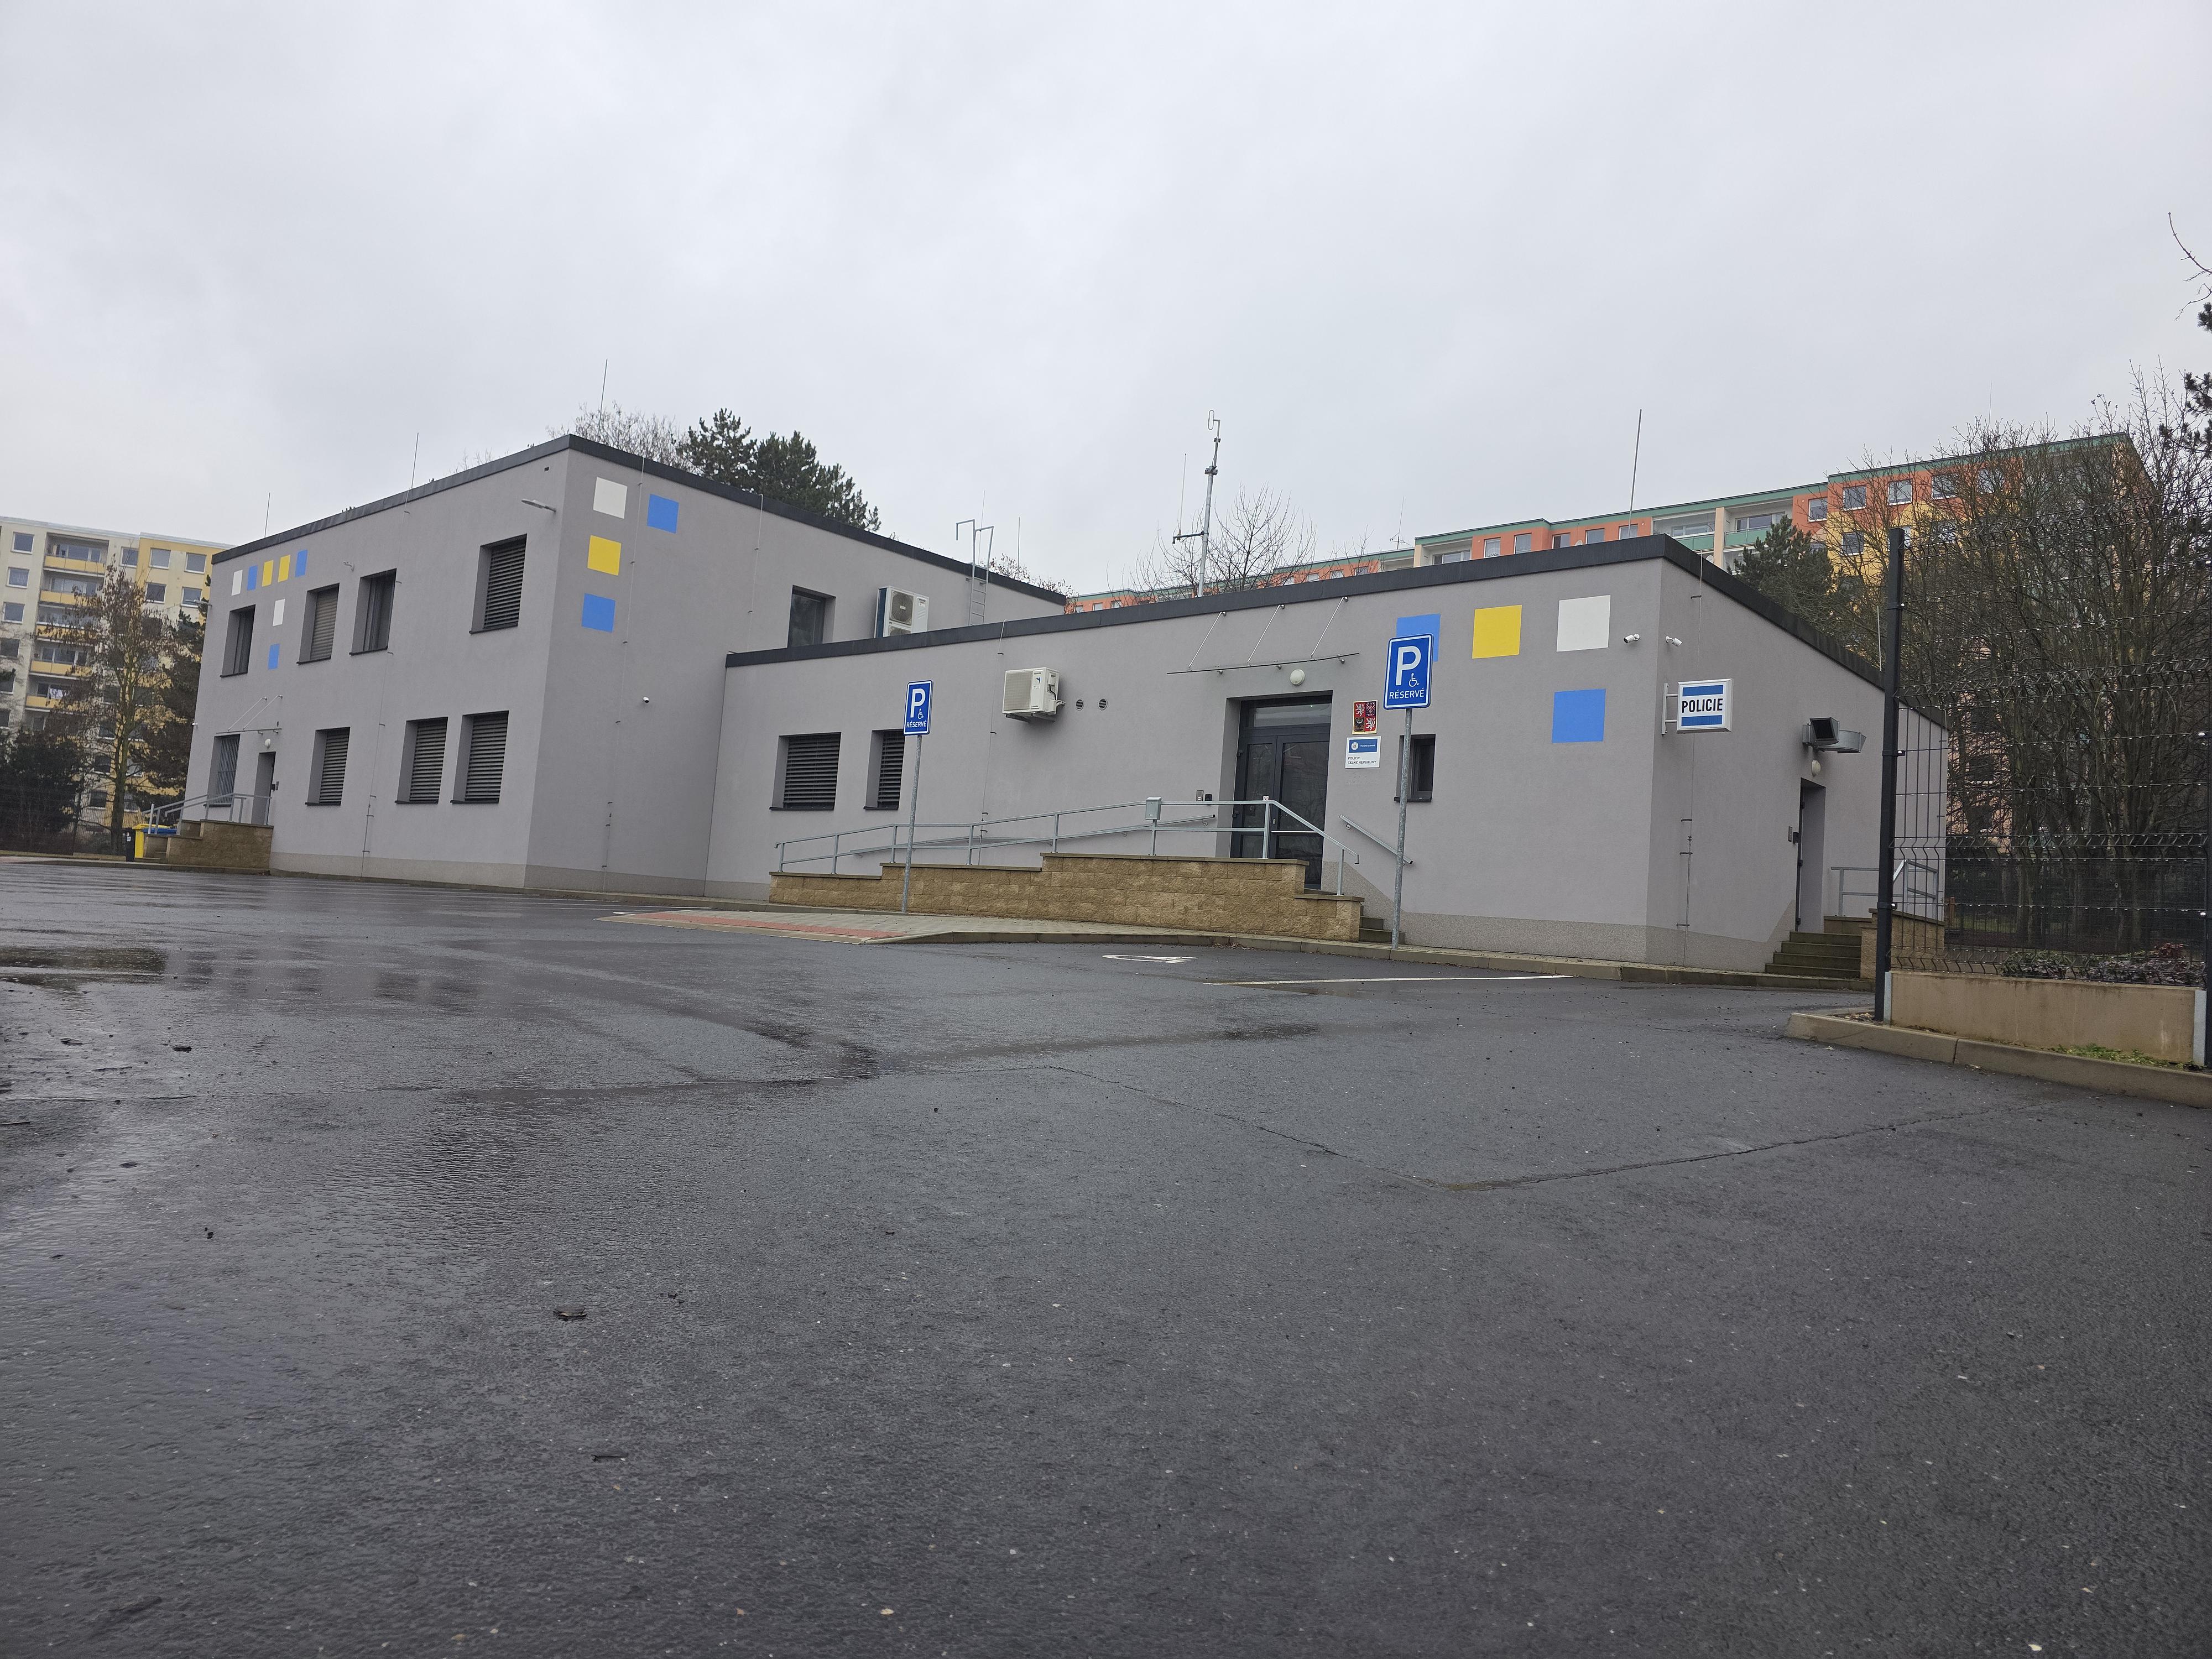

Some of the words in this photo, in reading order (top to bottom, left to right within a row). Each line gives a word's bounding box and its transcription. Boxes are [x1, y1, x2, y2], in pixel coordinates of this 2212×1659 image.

[1395, 646, 1421, 686] P
[1389, 687, 1425, 700] RÉSERVÉ
[910, 688, 926, 718] P
[1682, 698, 1724, 713] POLICIE
[906, 719, 927, 728] RÉSERVÉ
